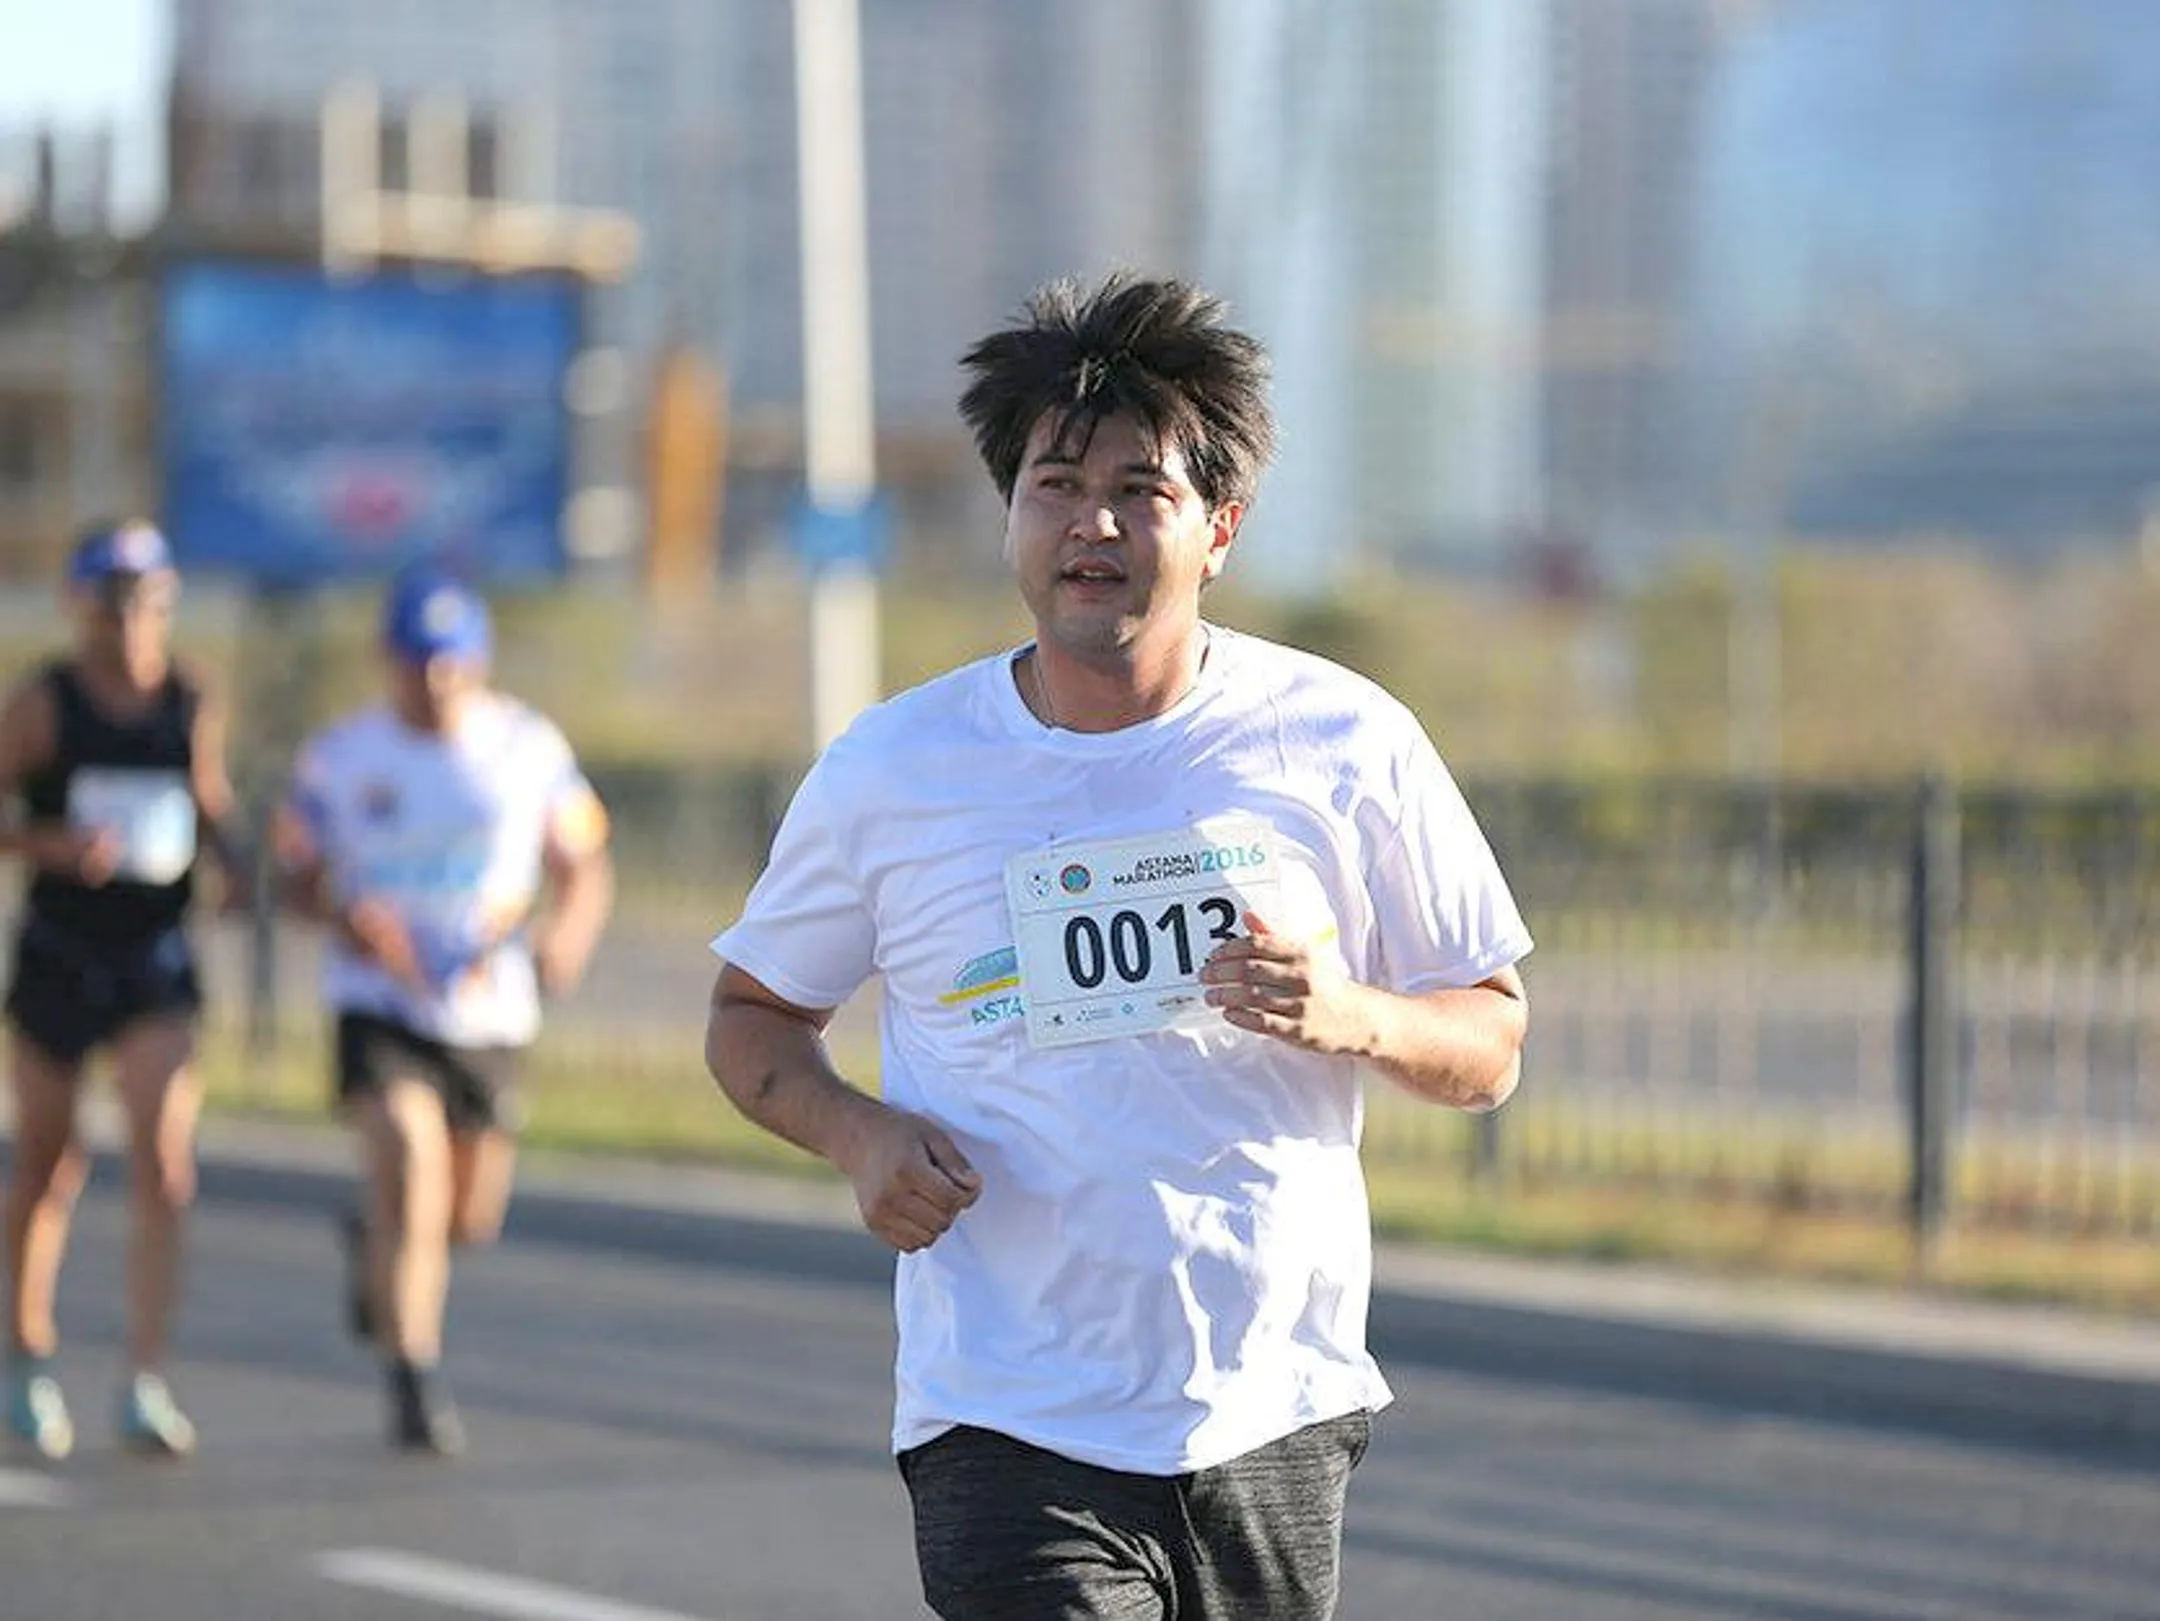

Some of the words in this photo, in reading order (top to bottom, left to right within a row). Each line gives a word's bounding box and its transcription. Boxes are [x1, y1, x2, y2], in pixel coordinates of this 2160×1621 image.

[1136, 854, 1193, 870] ASTANA
[1201, 843, 1266, 872] 2016
[1112, 865, 1196, 885] MARATHON
